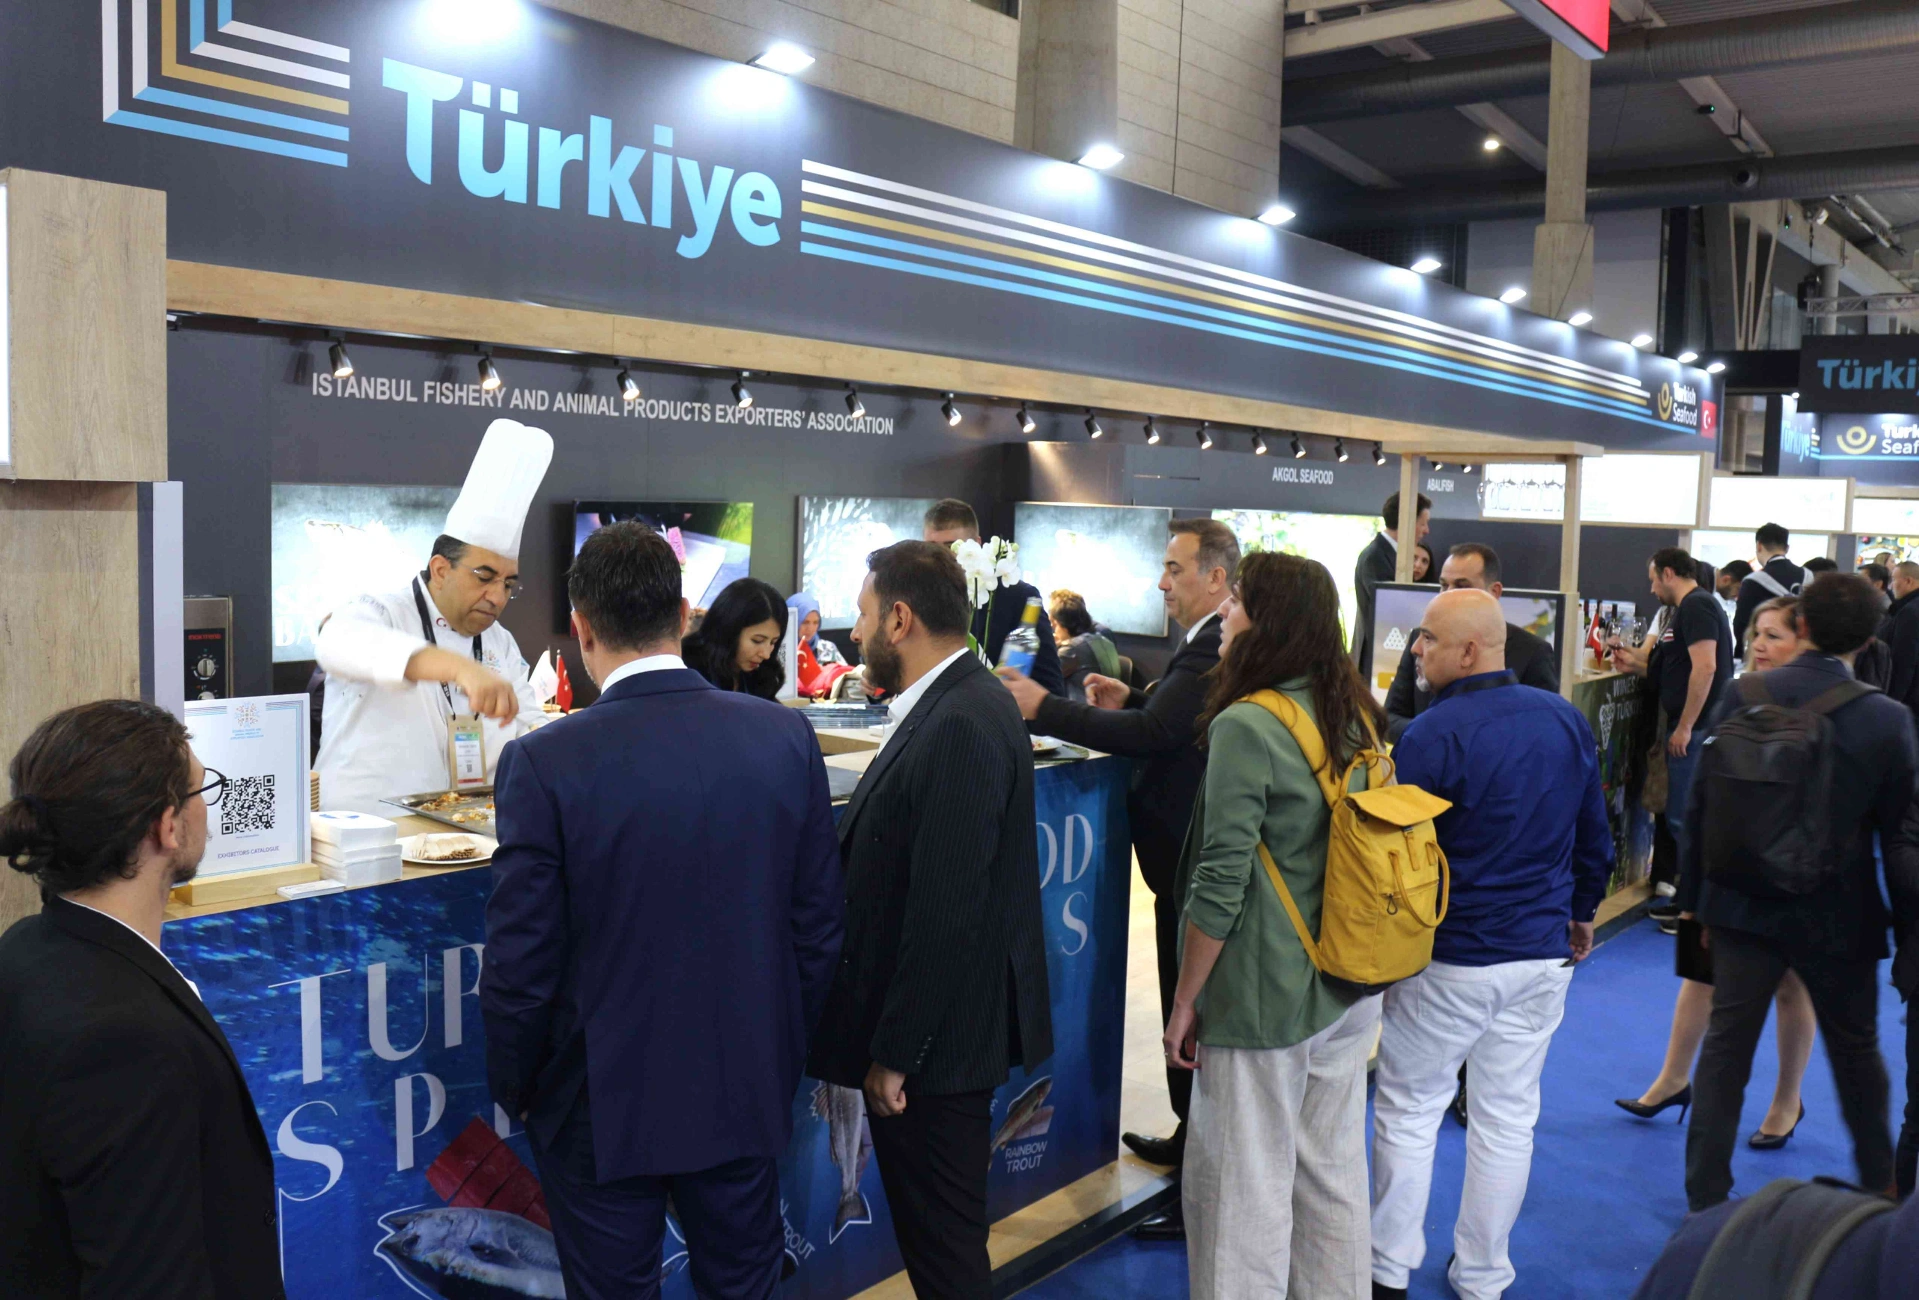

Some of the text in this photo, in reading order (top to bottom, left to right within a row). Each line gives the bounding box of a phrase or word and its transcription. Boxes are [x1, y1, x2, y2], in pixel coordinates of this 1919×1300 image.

[382, 57, 782, 259] Türkiye
[1817, 358, 1919, 396] Türki
[312, 372, 418, 402] ISTANBUL
[424, 381, 507, 408] FISHERY
[510, 389, 550, 411] AND
[553, 393, 619, 416] ANIMAL
[624, 398, 711, 422] PRODUCTS
[807, 412, 893, 435] ASSOCIATION
[1673, 381, 1697, 406] Turkish
[1672, 402, 1698, 426] Seafood
[1881, 423, 1919, 439] Turk
[1881, 439, 1919, 455] Seaf
[1272, 466, 1334, 485] AKGOL SEAFOOD
[250, 845, 280, 855] CATALOGUE
[1036, 813, 1094, 889] OD
[1005, 1141, 1048, 1160] RAINBOW
[1006, 1154, 1043, 1174] TROUT
